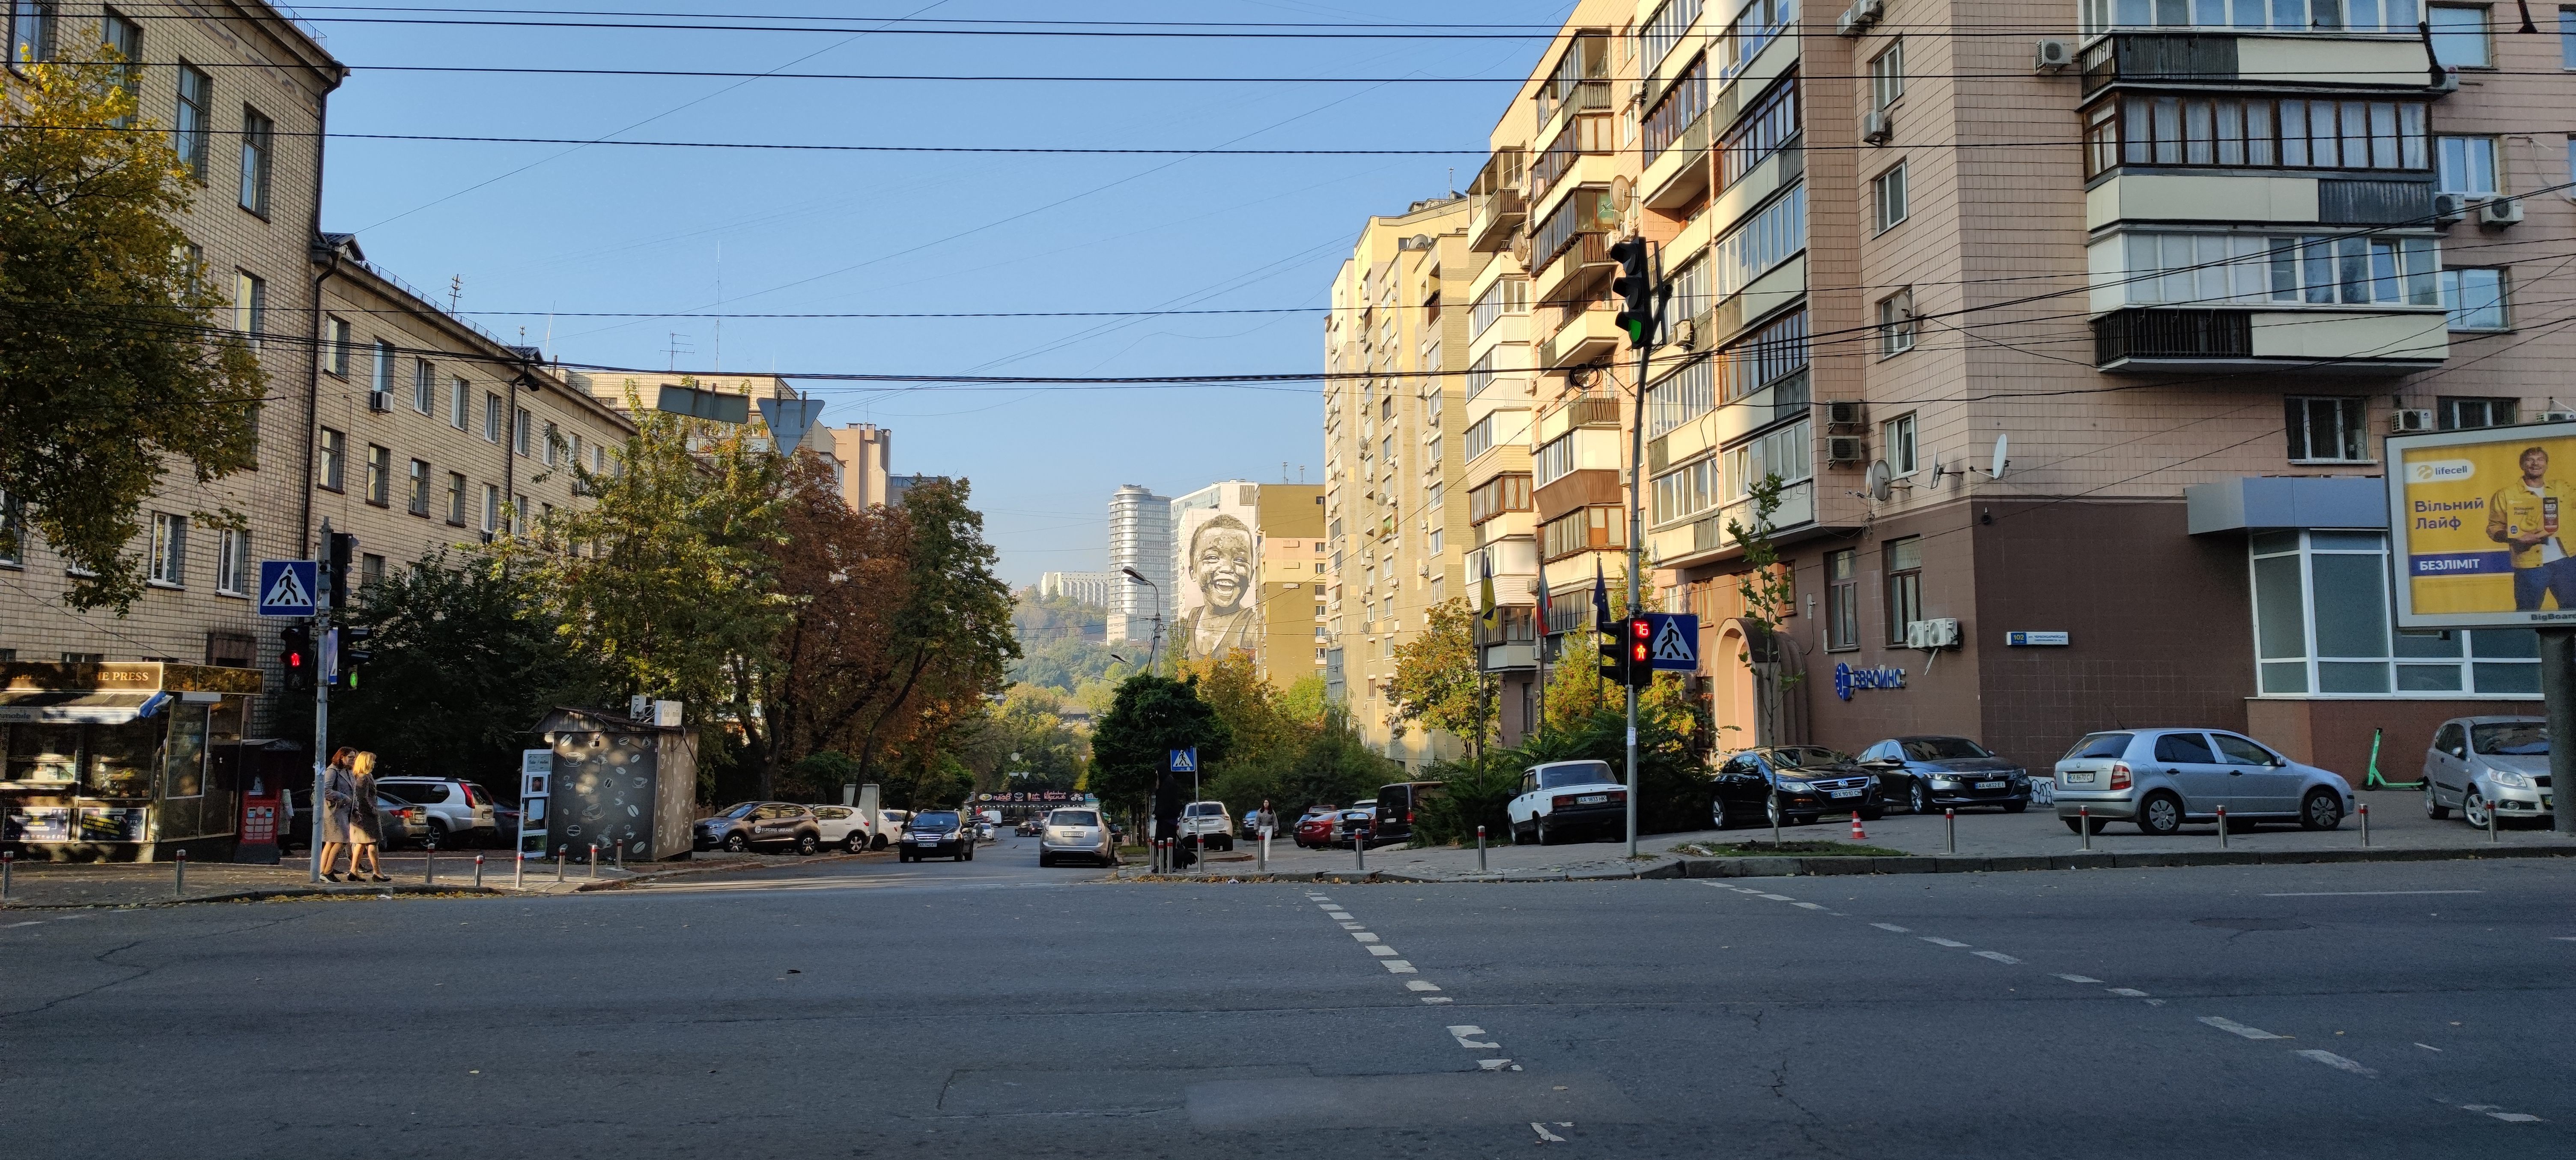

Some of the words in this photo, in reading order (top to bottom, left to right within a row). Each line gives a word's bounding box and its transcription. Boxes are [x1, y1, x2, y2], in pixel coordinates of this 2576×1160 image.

[2435, 465, 2467, 475] lifecell
[2415, 497, 2484, 512] Вільний
[2415, 516, 2462, 531] Лайф
[2420, 559, 2481, 571] БЕЗЛІМІТ
[1634, 623, 1649, 636] 76
[112, 672, 149, 681] PRESS
[1854, 669, 1903, 688] ЕВРОИНС
